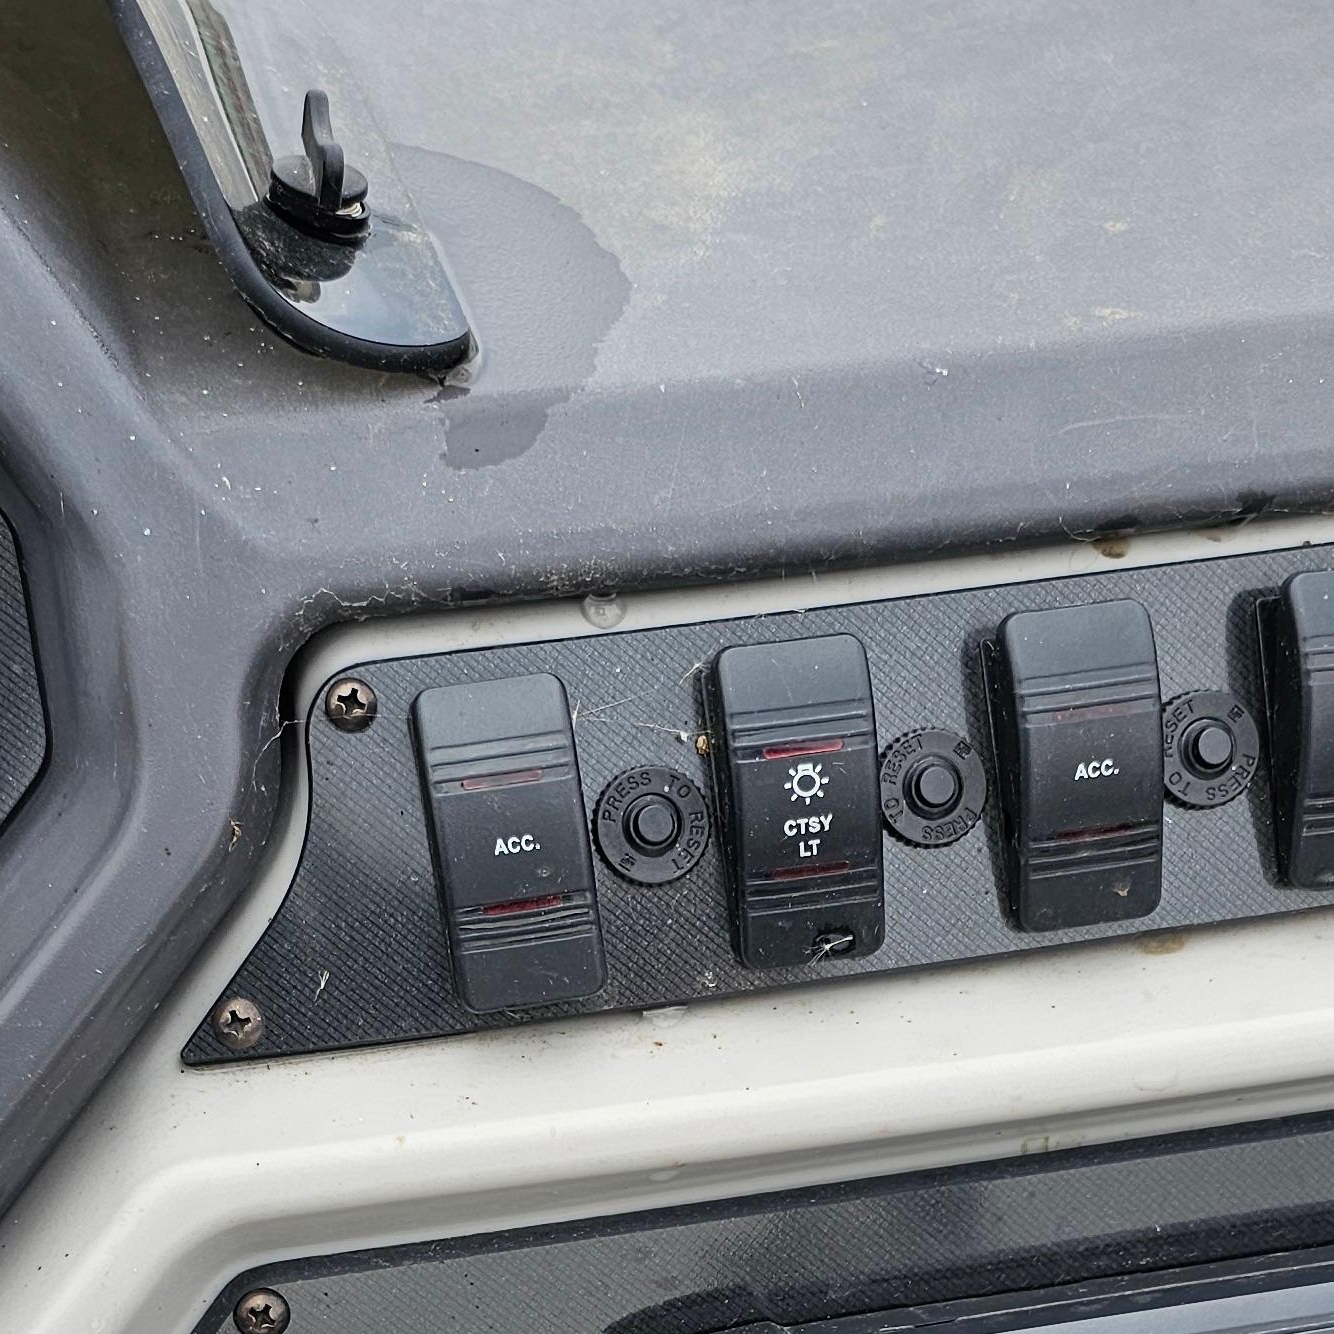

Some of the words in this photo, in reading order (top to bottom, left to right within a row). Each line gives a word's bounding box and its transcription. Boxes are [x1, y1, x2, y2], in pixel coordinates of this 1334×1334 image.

[882, 734, 922, 785] RESET
[1074, 759, 1120, 781] ACC.
[670, 775, 691, 798] TO
[1169, 772, 1190, 796] TO
[1206, 754, 1256, 800] PRESS
[603, 772, 651, 822] PRESS
[884, 798, 903, 823] TO
[784, 814, 833, 837] CTSY
[922, 807, 977, 840] PRESS
[494, 835, 541, 855] ACC.
[672, 812, 705, 873] RESET
[799, 839, 820, 857] LT
